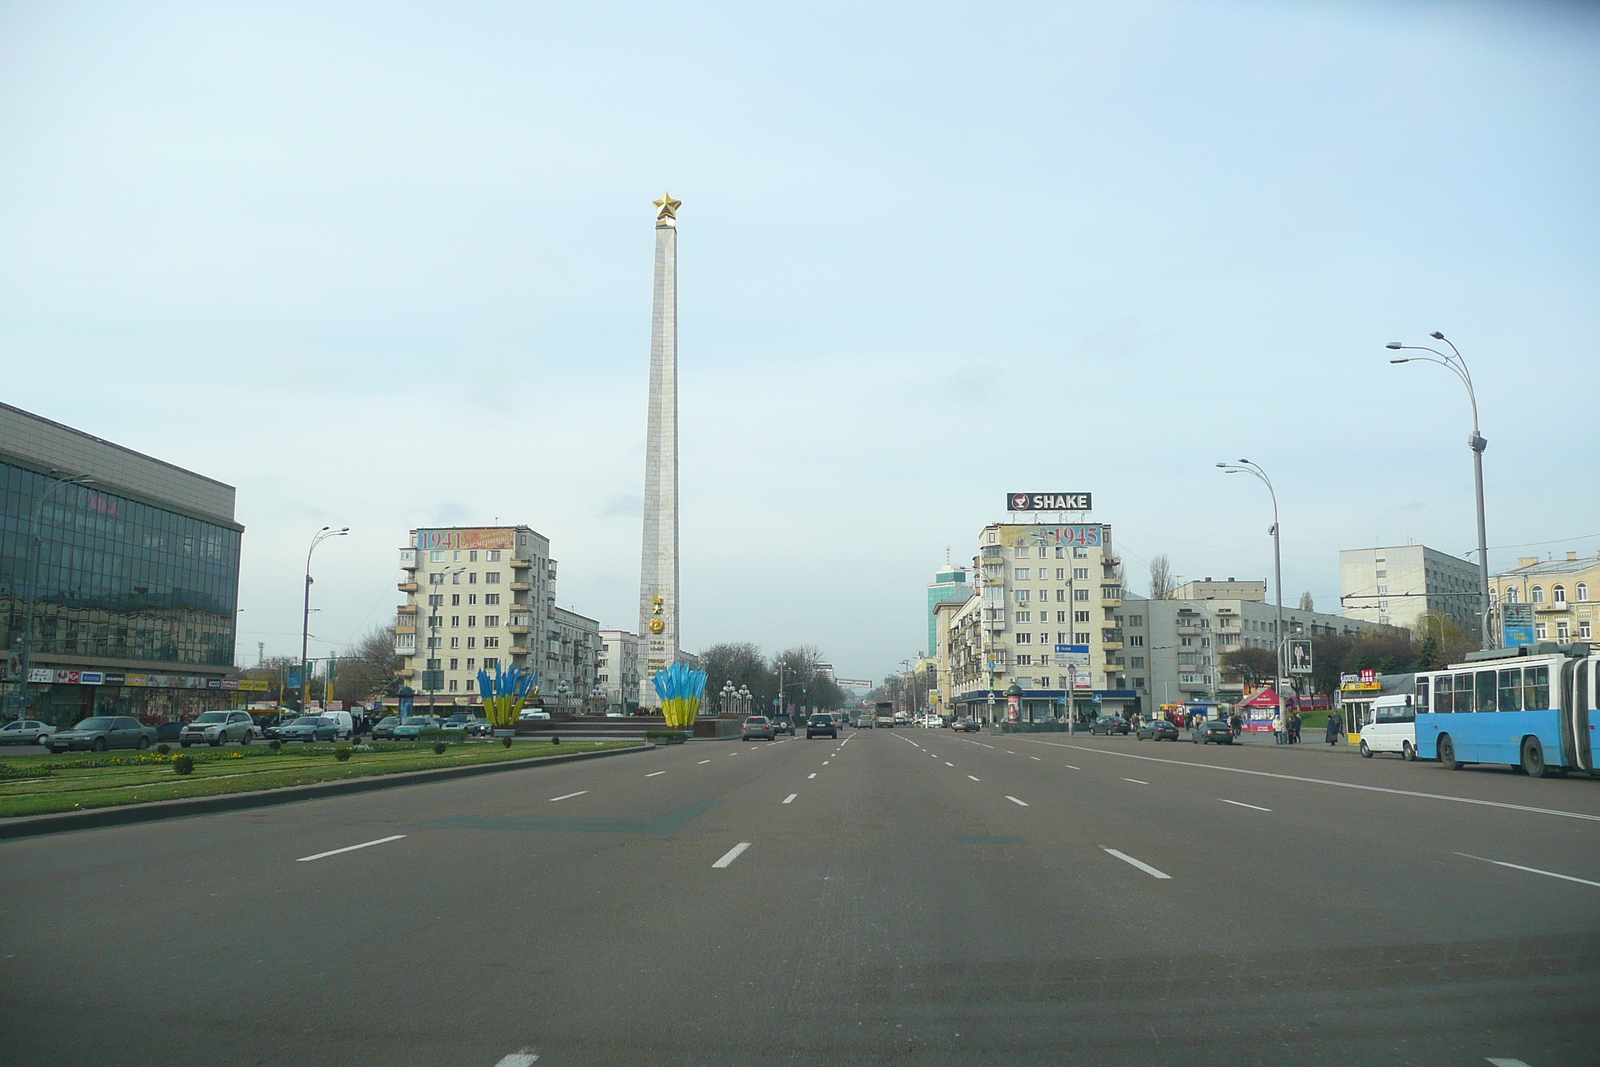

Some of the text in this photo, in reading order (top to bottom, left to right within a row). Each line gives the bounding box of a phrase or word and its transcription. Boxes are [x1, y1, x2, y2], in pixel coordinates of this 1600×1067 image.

[1034, 495, 1087, 508] SHAKE
[421, 532, 461, 549] 1941
[1054, 527, 1097, 545] 1945
